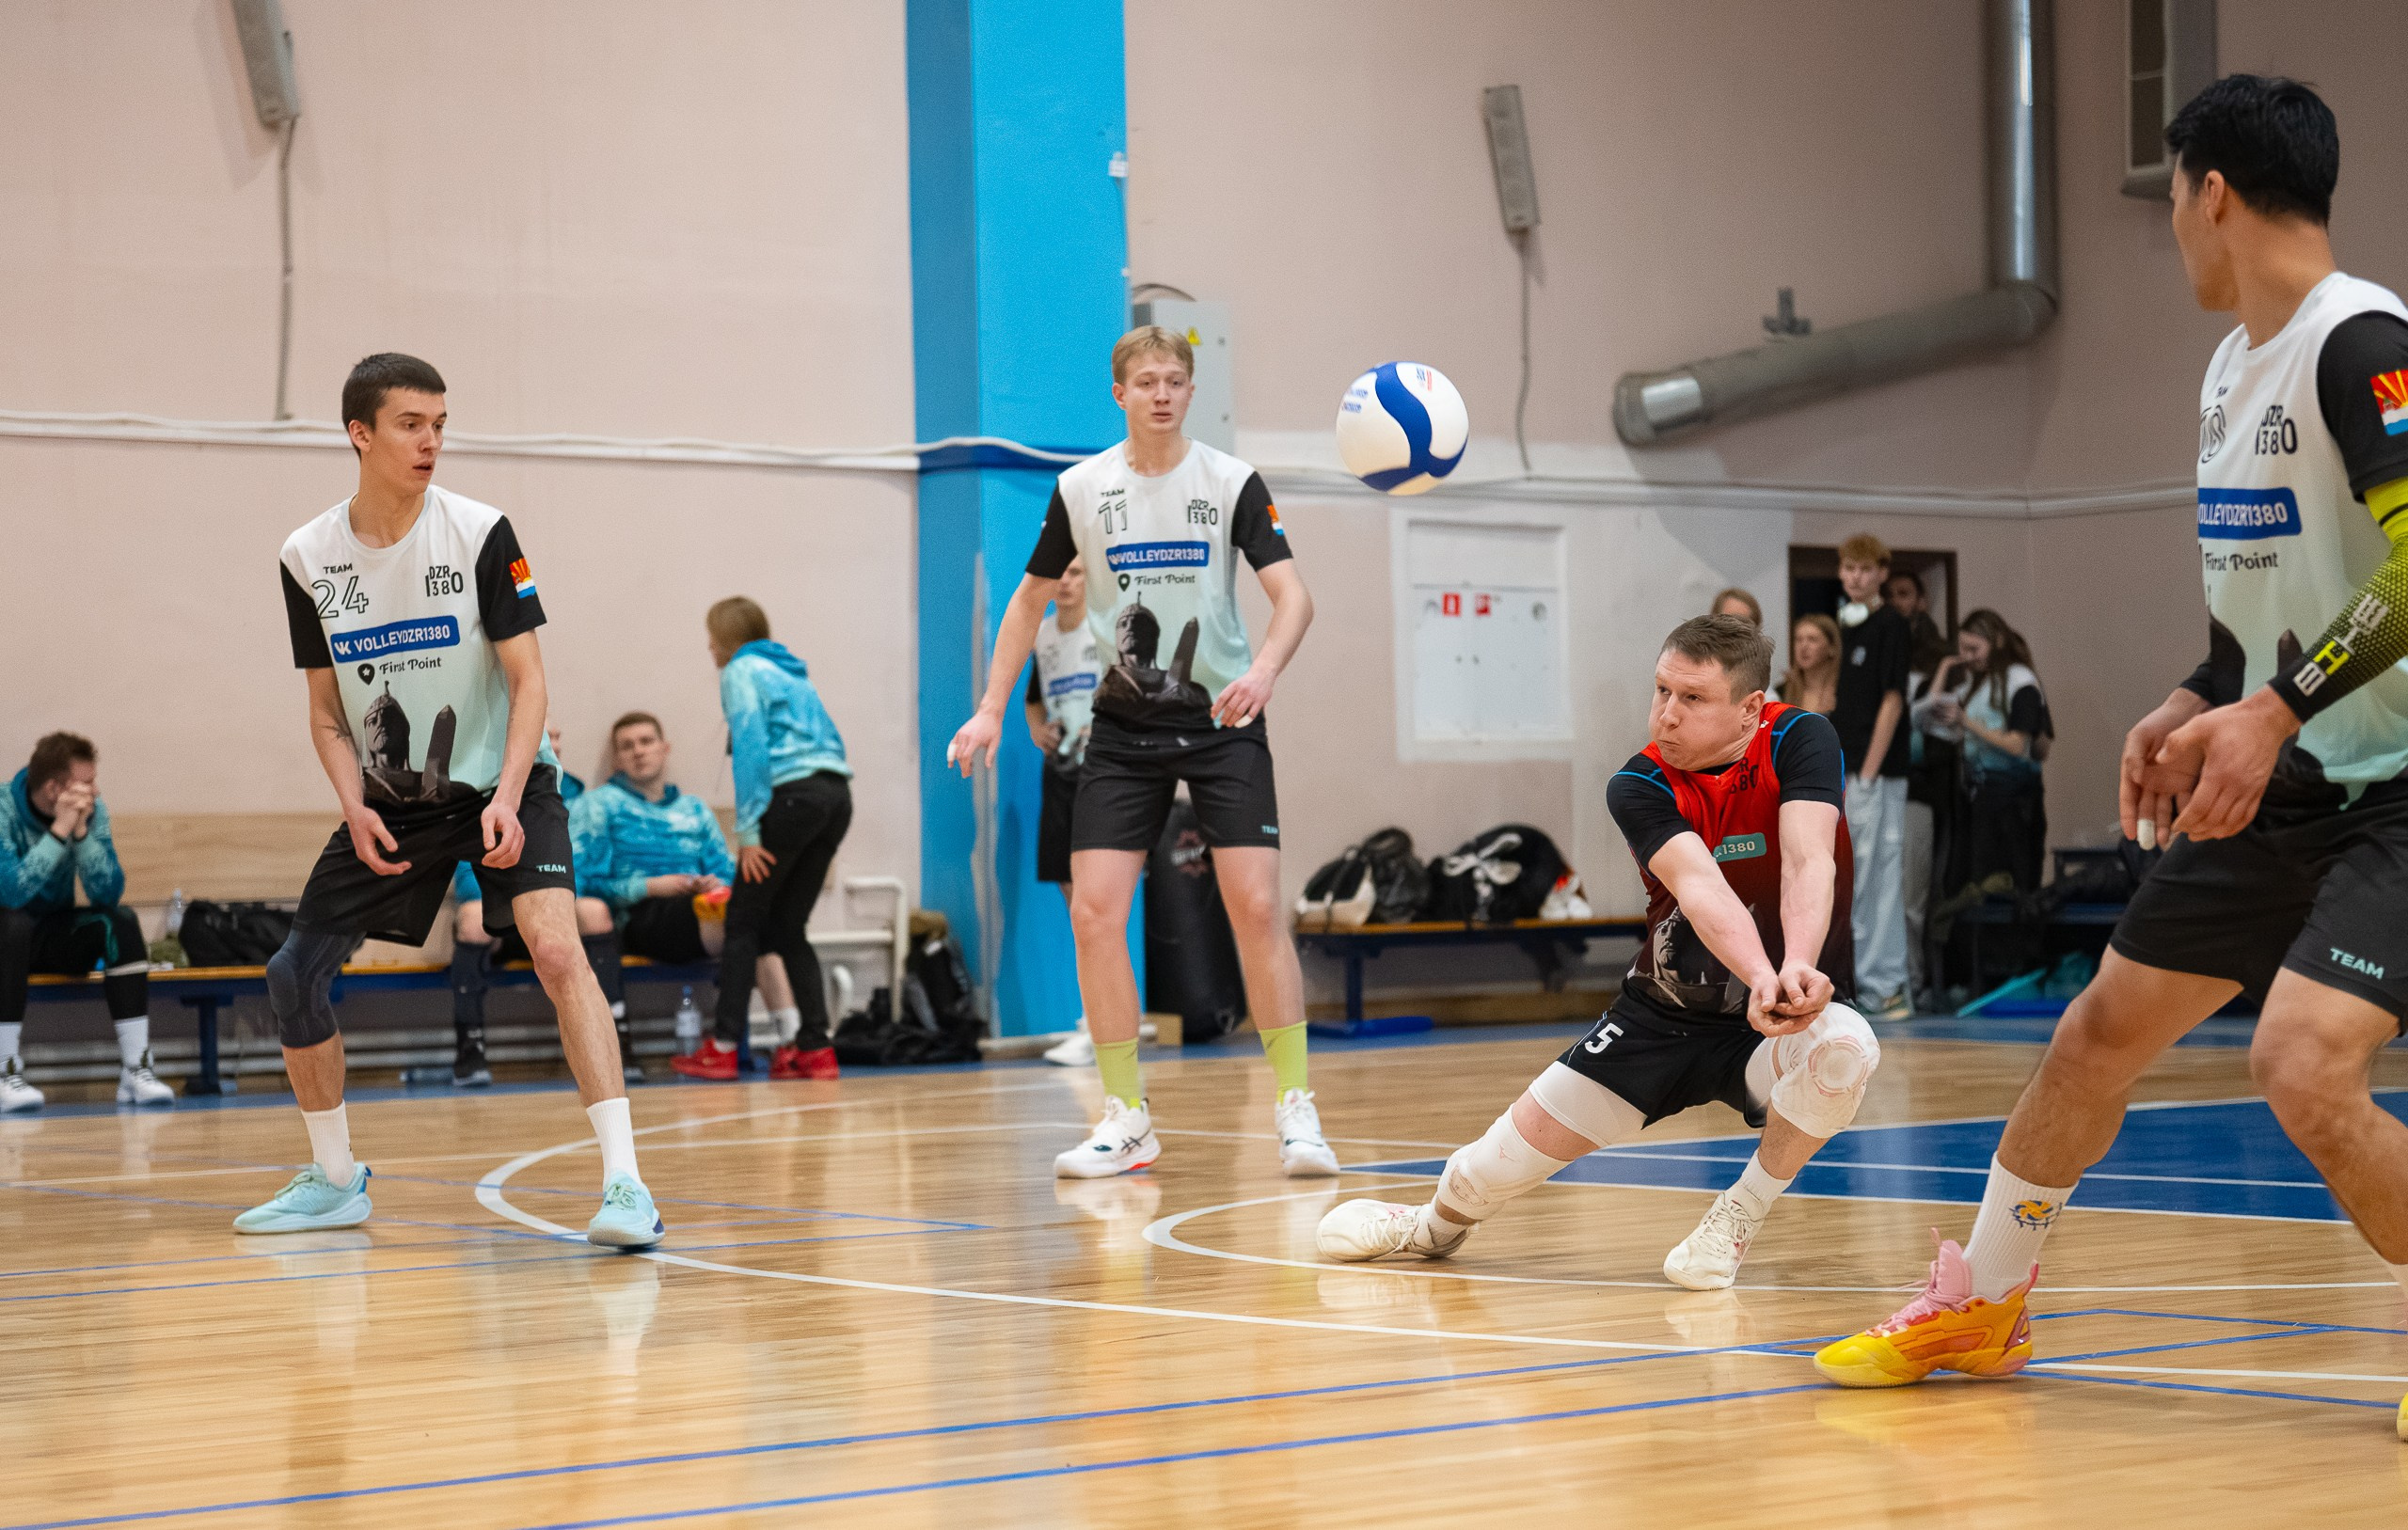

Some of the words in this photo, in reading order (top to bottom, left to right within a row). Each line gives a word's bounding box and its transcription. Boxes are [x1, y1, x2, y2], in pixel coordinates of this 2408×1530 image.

[2255, 418, 2298, 455] 1380
[1187, 505, 1218, 526] 1380
[323, 563, 354, 575] TEAM
[2229, 552, 2279, 572] Point
[429, 565, 451, 580] DZR
[1133, 575, 1163, 586] First
[1164, 574, 1196, 584] Point
[425, 571, 465, 597] 1380
[311, 576, 370, 620] 24
[354, 624, 452, 653] VOLLEYDZR1380
[379, 660, 406, 675] First
[407, 657, 442, 670] Point
[1716, 841, 1756, 858] 1380
[536, 863, 567, 875] TEAM
[2330, 946, 2385, 980] TEAM
[1584, 1022, 1624, 1054] 5
